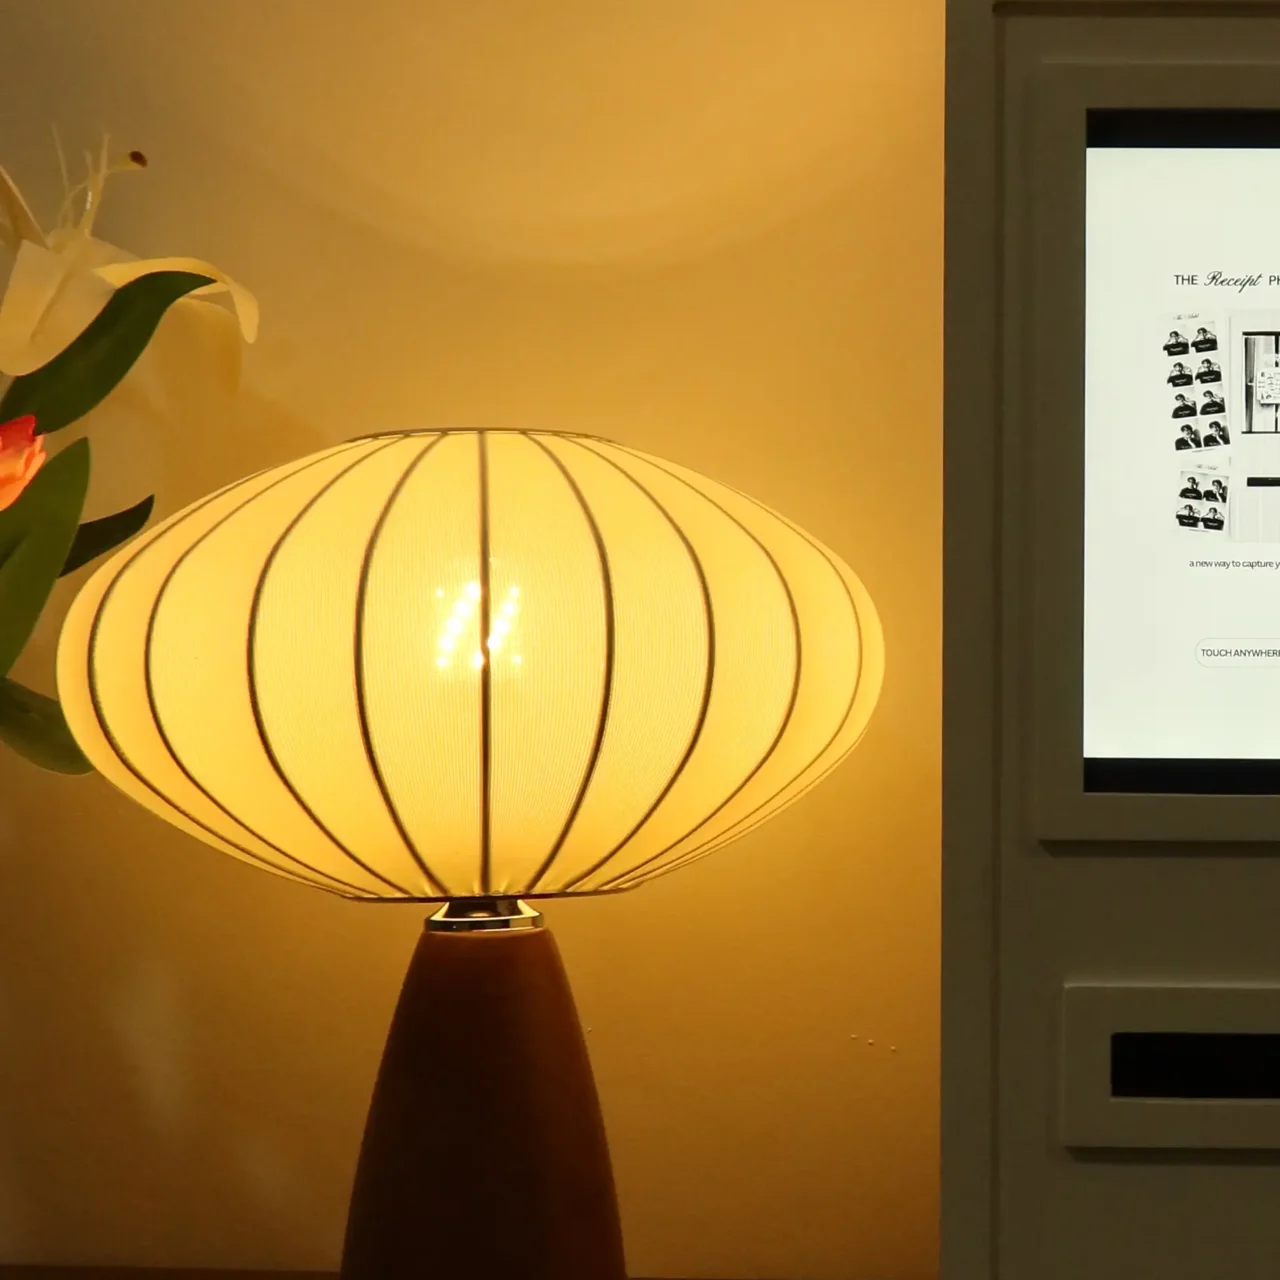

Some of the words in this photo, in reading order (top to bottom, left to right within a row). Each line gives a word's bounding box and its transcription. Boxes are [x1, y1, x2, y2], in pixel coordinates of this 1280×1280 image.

[1173, 274, 1199, 286] THE
[1203, 271, 1263, 293] Receipt
[1189, 560, 1195, 568] a
[1195, 560, 1213, 568] new
[1213, 560, 1231, 570] way
[1231, 560, 1241, 568] to
[1241, 560, 1275, 570] capture
[1200, 648, 1232, 658] TOUCH
